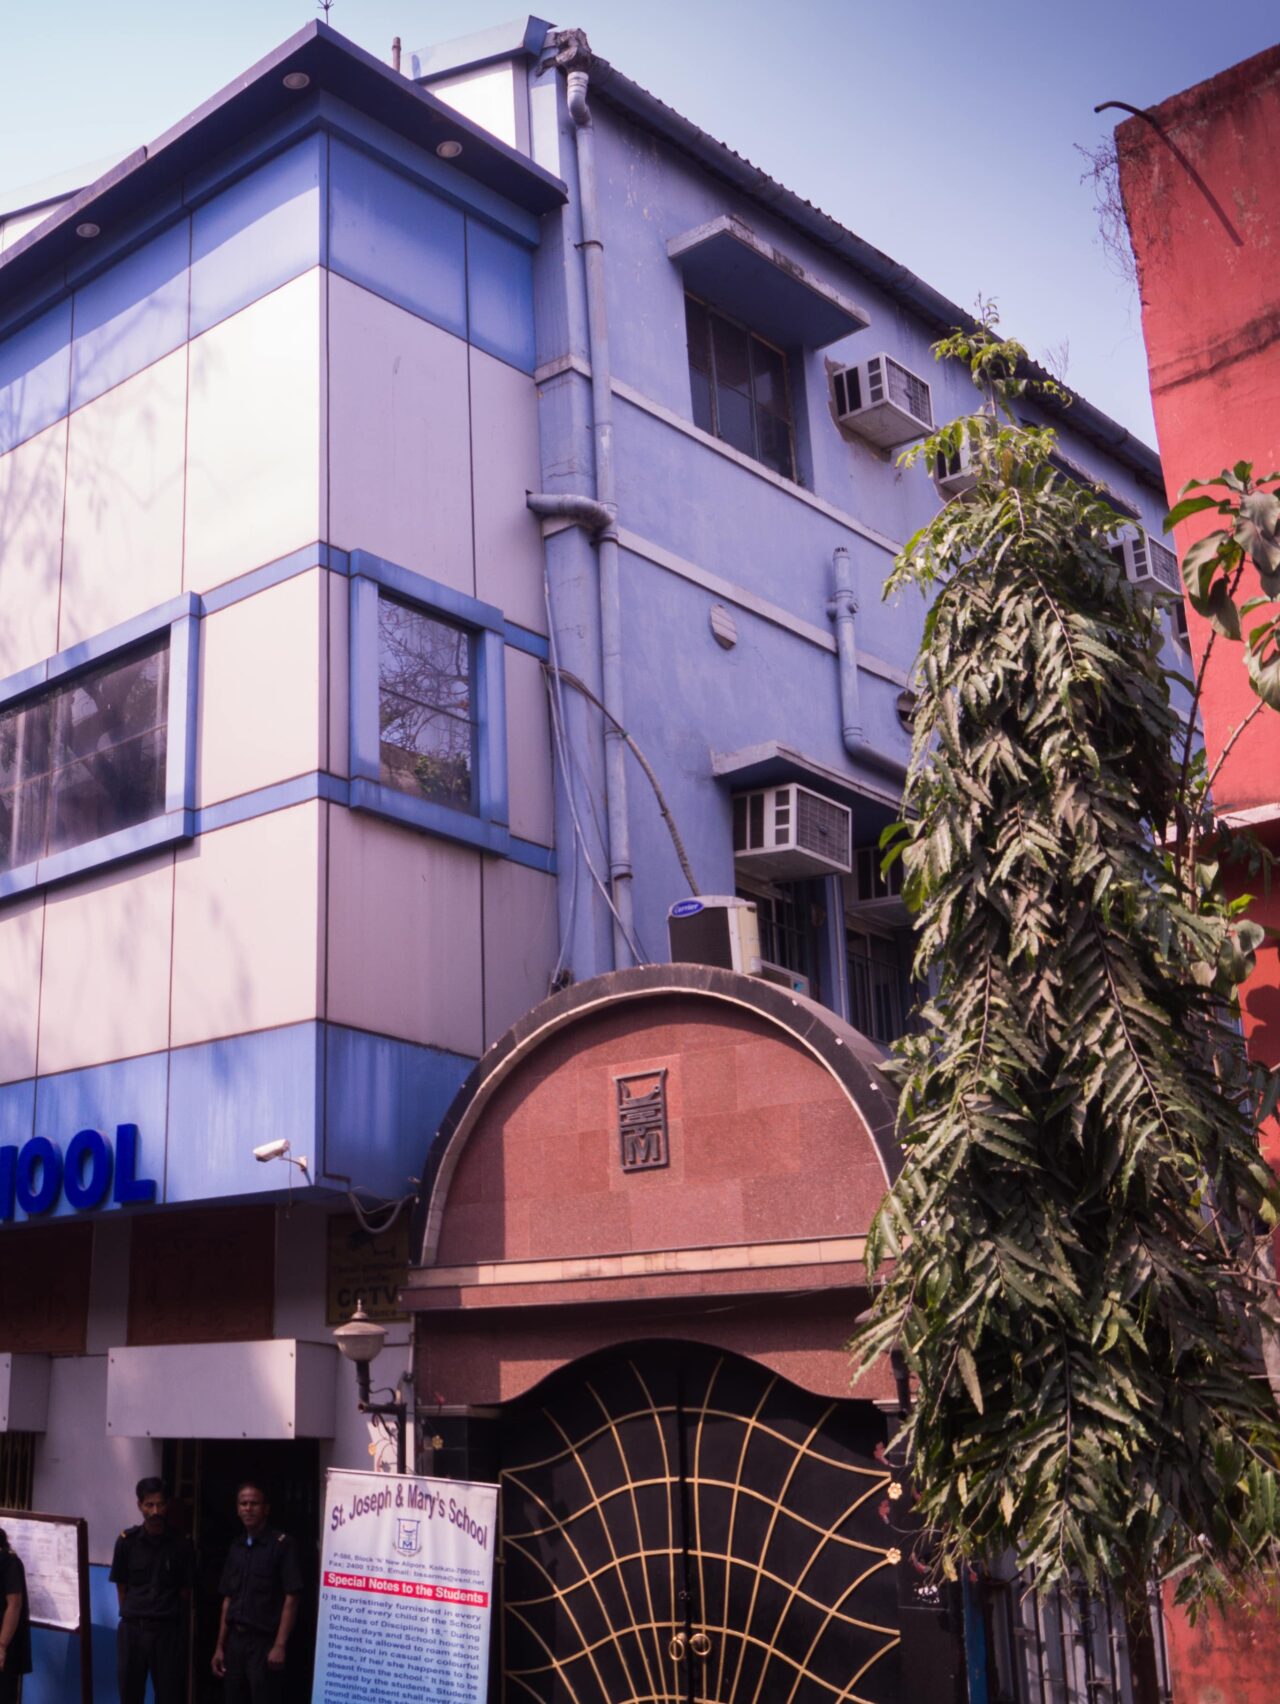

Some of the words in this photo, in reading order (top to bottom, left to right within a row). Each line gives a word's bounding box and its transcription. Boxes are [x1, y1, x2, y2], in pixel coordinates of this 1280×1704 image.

[338, 1286, 398, 1307] CCTV
[331, 1504, 346, 1531] St.
[349, 1485, 391, 1520] Joseph
[395, 1483, 404, 1508] &
[408, 1484, 446, 1520] Mary's
[448, 1498, 487, 1550] School
[328, 1573, 366, 1588] Special
[368, 1578, 400, 1592] Notes
[402, 1583, 414, 1594] to
[416, 1585, 433, 1597] the
[435, 1587, 484, 1604] Students
[332, 1604, 353, 1613] diary
[368, 1610, 392, 1618] every
[395, 1612, 418, 1621] child
[432, 1617, 446, 1625] the
[450, 1620, 481, 1630] School
[350, 1598, 393, 1610] pristinely
[396, 1602, 441, 1615] furnished
[455, 1612, 481, 1622] every
[329, 1624, 359, 1633] School
[362, 1629, 383, 1637] days
[386, 1632, 402, 1640] and
[405, 1634, 436, 1645] School
[440, 1639, 465, 1649] hours
[343, 1616, 367, 1625] Rules
[381, 1621, 427, 1634] Discipline)
[450, 1631, 480, 1642] During
[328, 1634, 362, 1644] student
[376, 1640, 411, 1650] allowed
[426, 1648, 450, 1656] roam
[453, 1652, 479, 1660] about
[345, 1646, 376, 1655] school
[390, 1652, 422, 1661] casual
[436, 1659, 480, 1670] colourful
[327, 1662, 355, 1671] absent
[356, 1666, 376, 1674] from
[378, 1669, 392, 1677] the
[439, 1679, 454, 1687] has
[328, 1652, 357, 1663] dress,
[387, 1661, 405, 1669] she
[408, 1664, 451, 1676] happens
[466, 1673, 479, 1681] be
[324, 1690, 350, 1699] round
[352, 1694, 376, 1703] about
[325, 1680, 368, 1694] remaining
[370, 1688, 400, 1698] absent
[402, 1692, 424, 1701] shall
[426, 1696, 451, 1704] never
[326, 1672, 359, 1681] obeyed
[362, 1676, 371, 1685] by
[374, 1678, 389, 1686] the
[436, 1688, 477, 1700] Students
